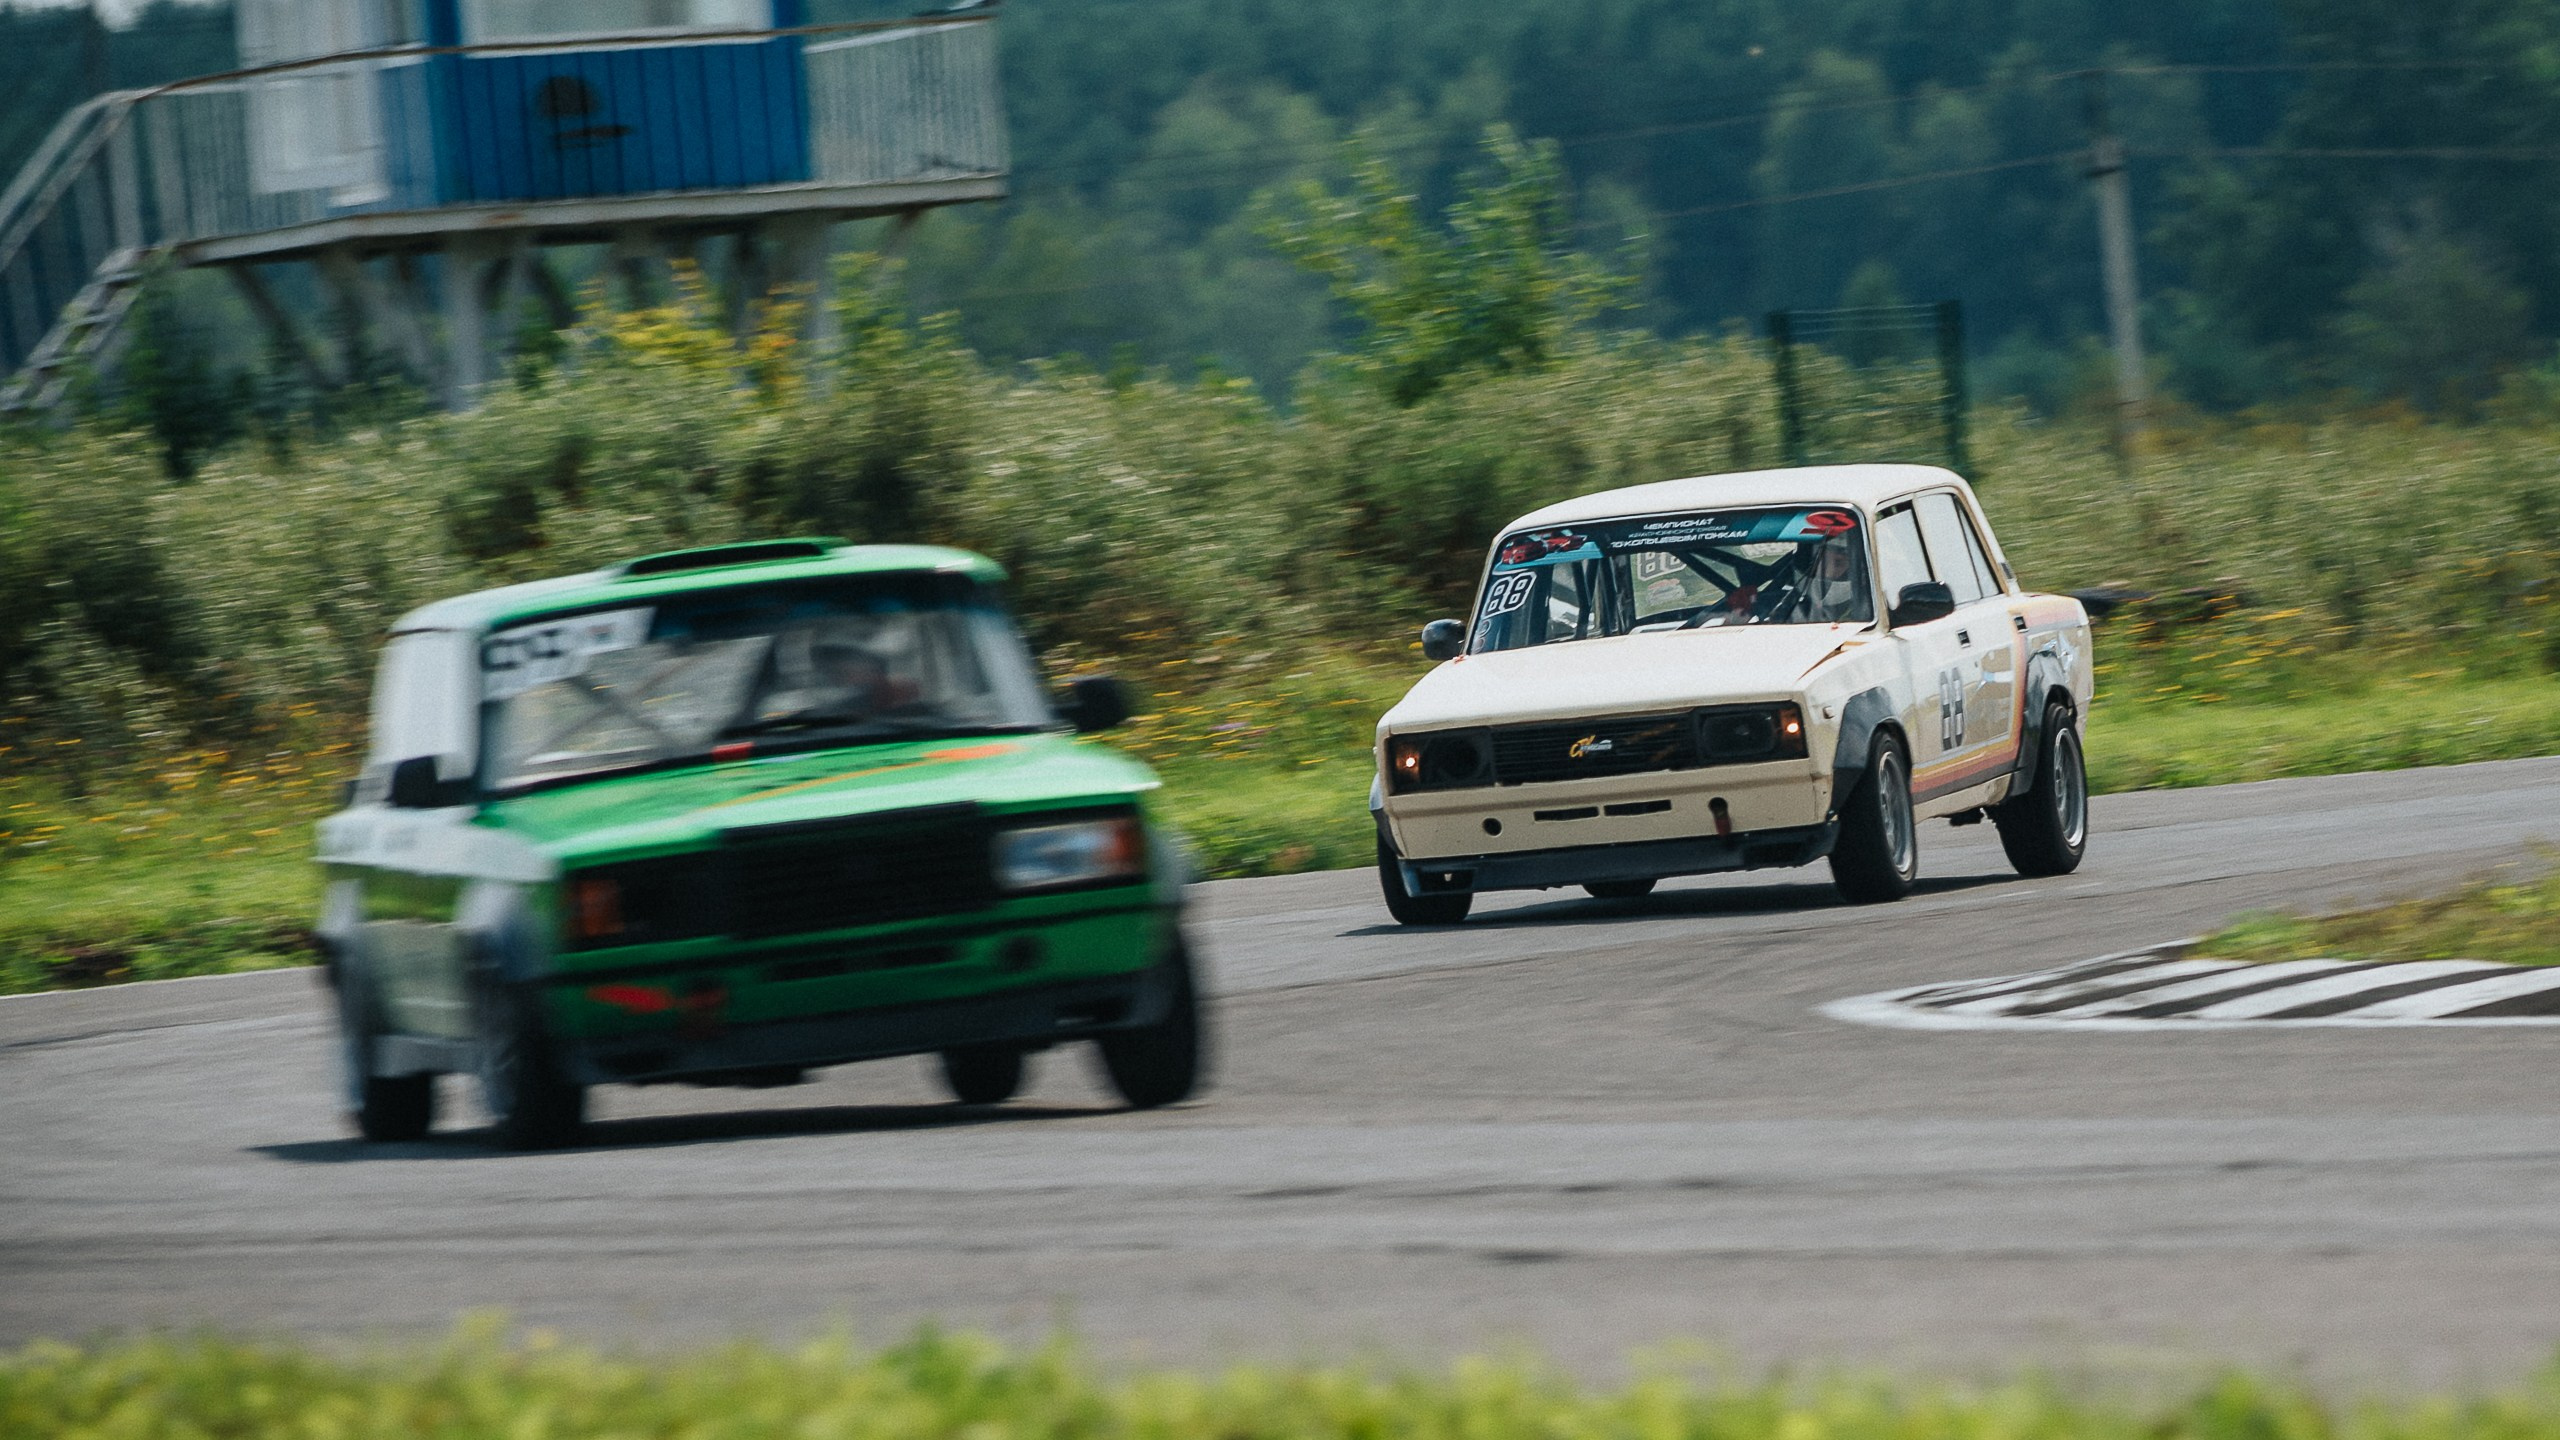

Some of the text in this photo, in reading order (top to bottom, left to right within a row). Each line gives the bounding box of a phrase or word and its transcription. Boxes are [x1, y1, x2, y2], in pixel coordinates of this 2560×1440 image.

[1623, 533, 1698, 547] КОЛЬЦЕВЫМ
[1698, 530, 1749, 541] ГОНКАМ
[1643, 517, 1715, 530] ЧЕМПИОНАТ
[1481, 572, 1538, 619] 88
[1939, 666, 1964, 751] 88
